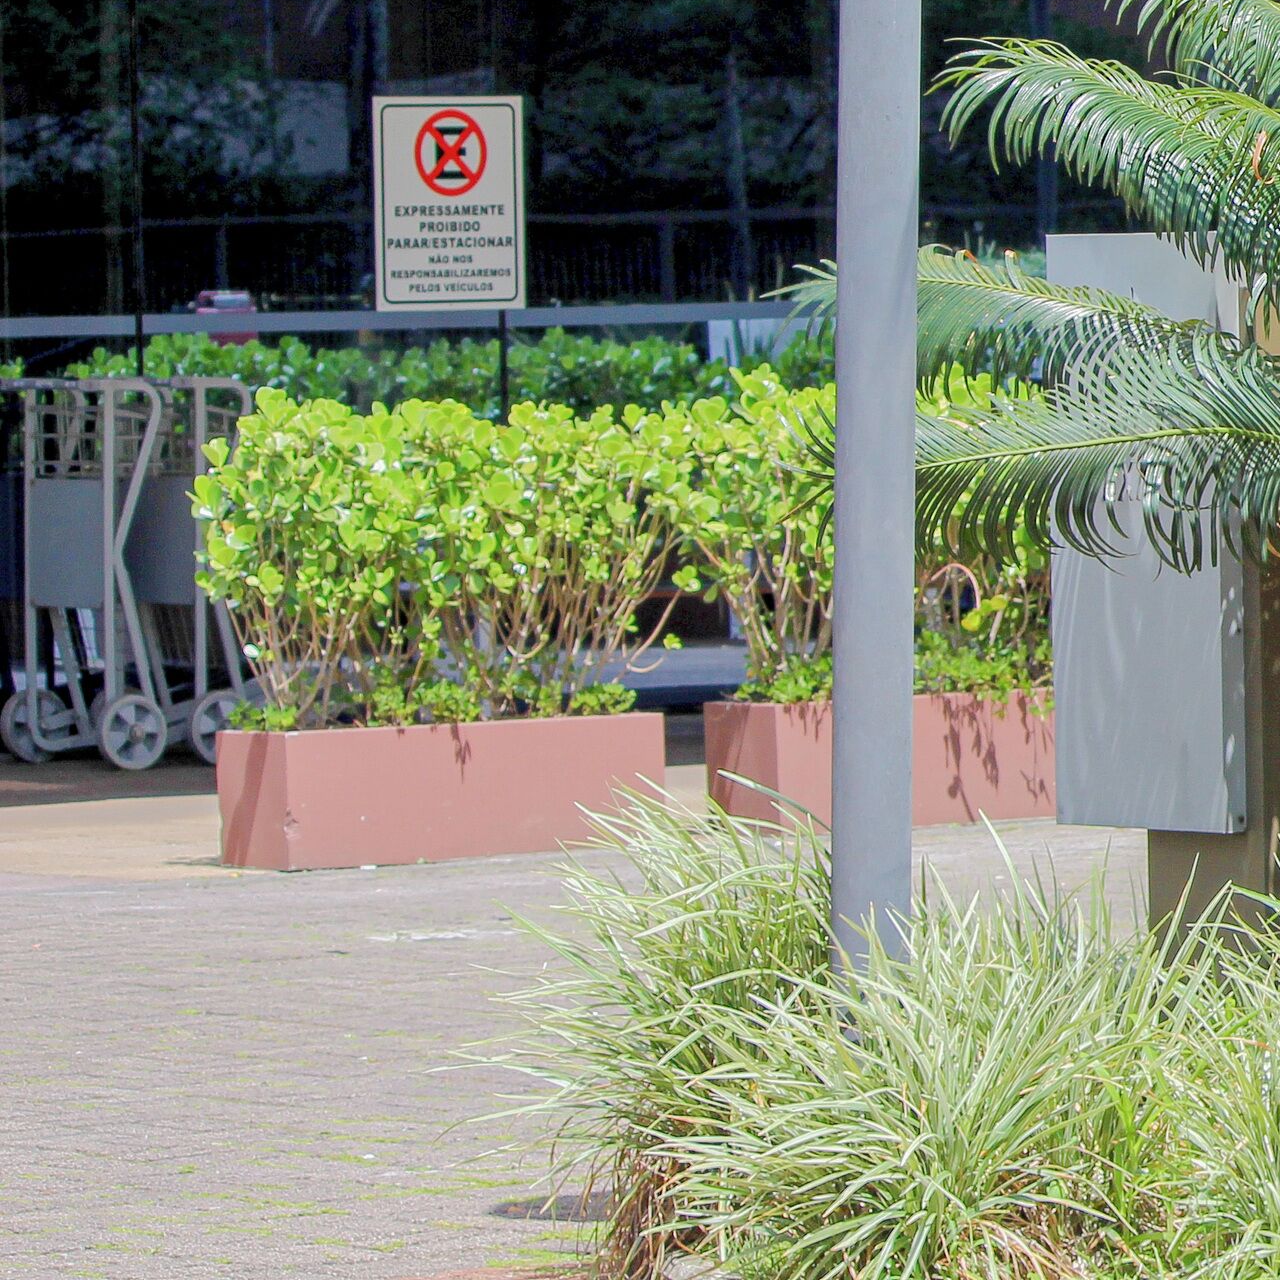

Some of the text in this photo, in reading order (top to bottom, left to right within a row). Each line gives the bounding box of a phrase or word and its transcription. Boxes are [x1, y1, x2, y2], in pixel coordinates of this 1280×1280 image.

[394, 204, 505, 217] EXPRESSAMENTE
[419, 221, 481, 233] PROIBIDO
[387, 236, 513, 249] PARAR/ESTACIONAR
[428, 253, 473, 264] NÃO NOS
[390, 268, 511, 279] RESPONSABILIZAREMOS
[409, 282, 494, 293] PELOS VEÍCULOS
